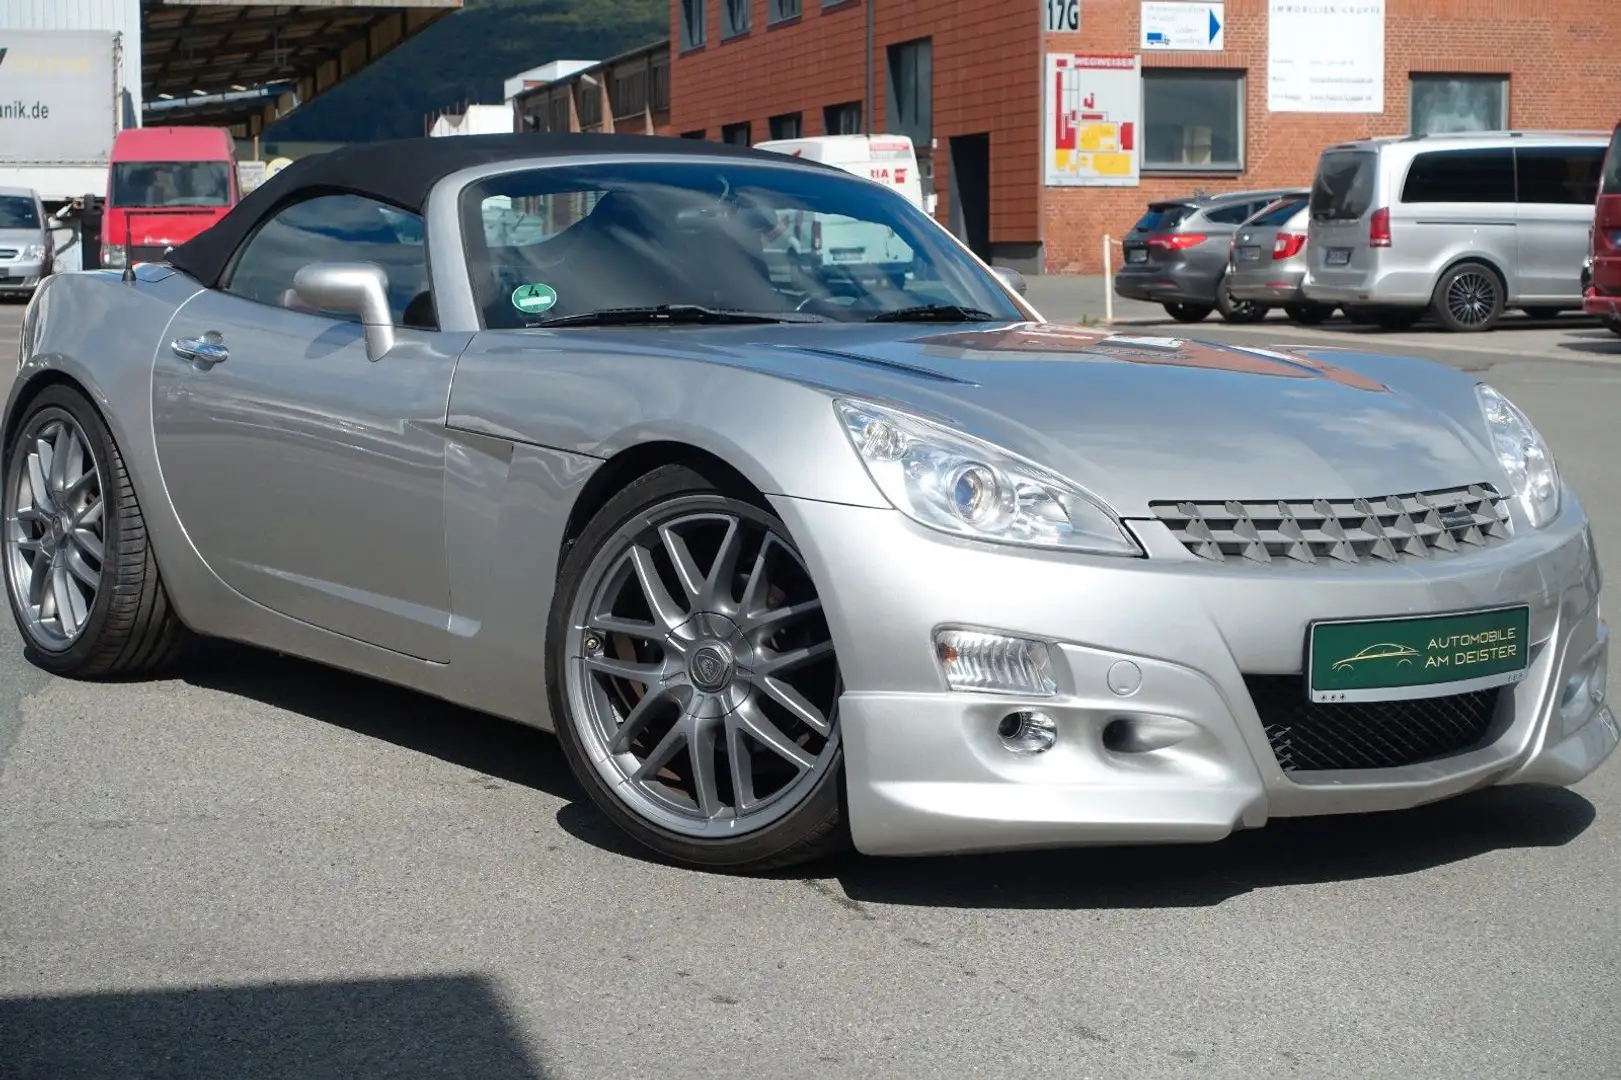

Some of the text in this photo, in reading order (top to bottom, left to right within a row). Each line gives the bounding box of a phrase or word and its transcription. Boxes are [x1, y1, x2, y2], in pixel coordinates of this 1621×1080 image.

[1049, 0, 1079, 31] 17G
[1427, 627, 1516, 648] AUTOMOBILE
[1424, 644, 1516, 668] AM DEISTER
